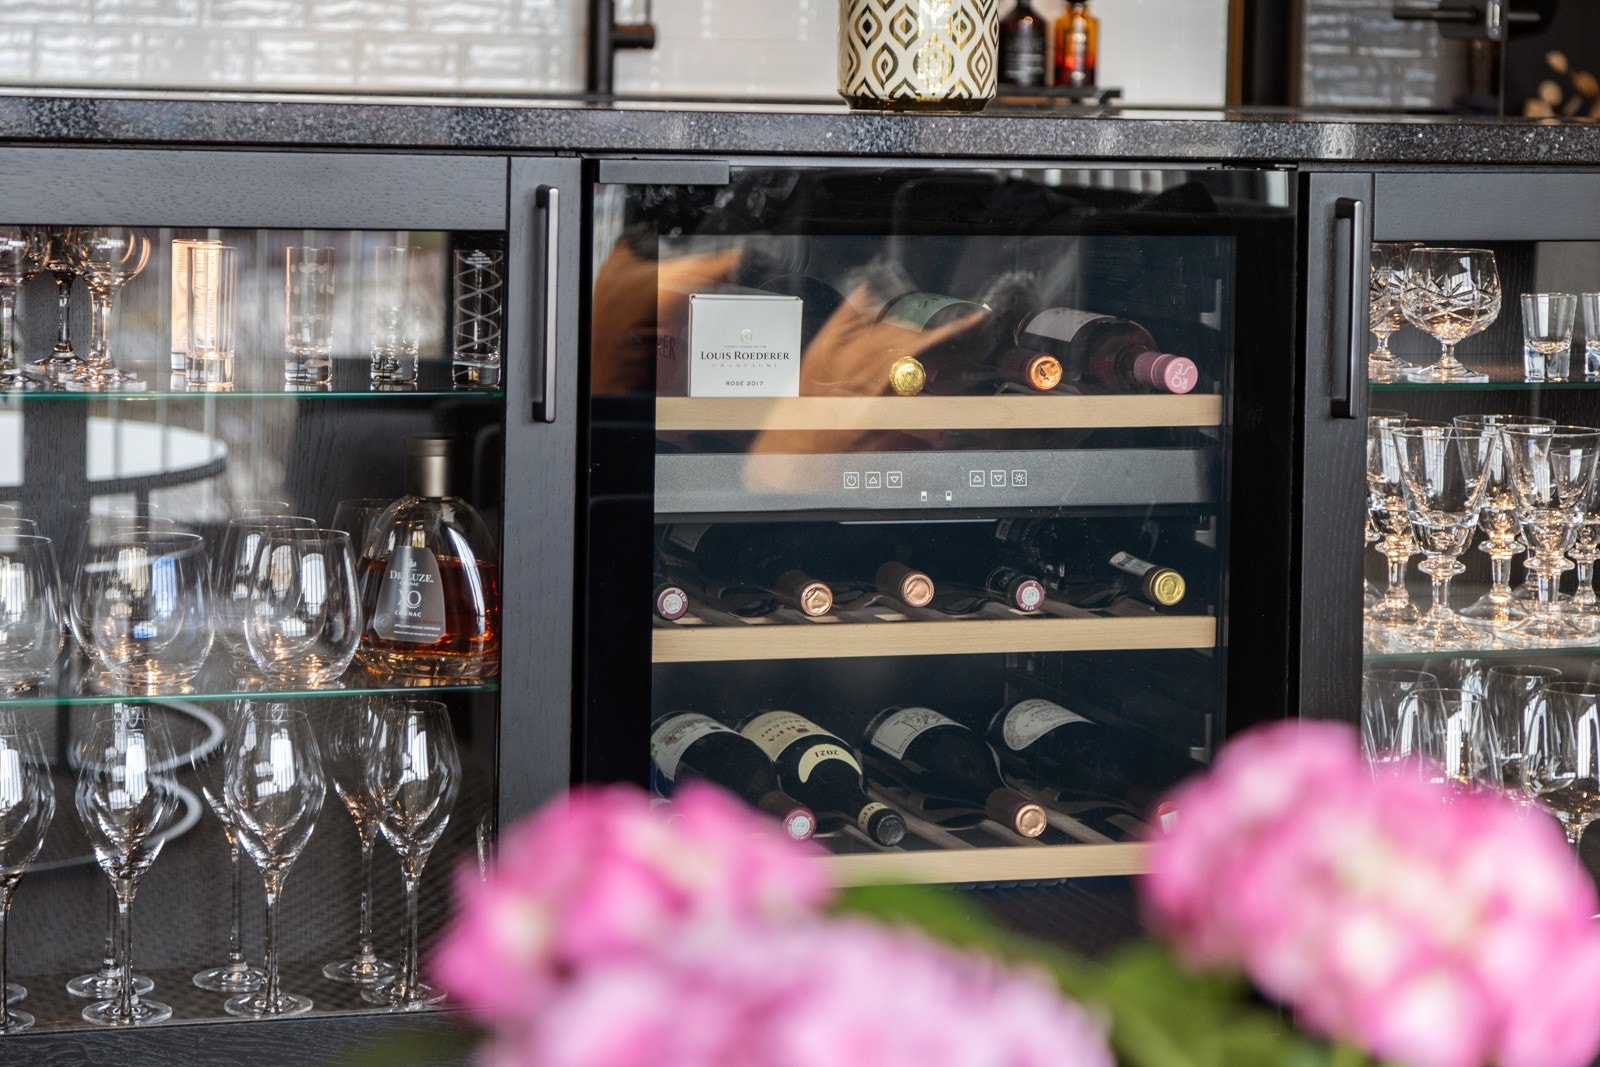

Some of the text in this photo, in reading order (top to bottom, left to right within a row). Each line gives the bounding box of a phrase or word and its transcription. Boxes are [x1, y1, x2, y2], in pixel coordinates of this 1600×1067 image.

[701, 350, 790, 360] LOUIS ROEDERER
[725, 379, 745, 387] ROSÉ
[394, 610, 422, 618] COGNAC
[814, 749, 840, 759] 2021
